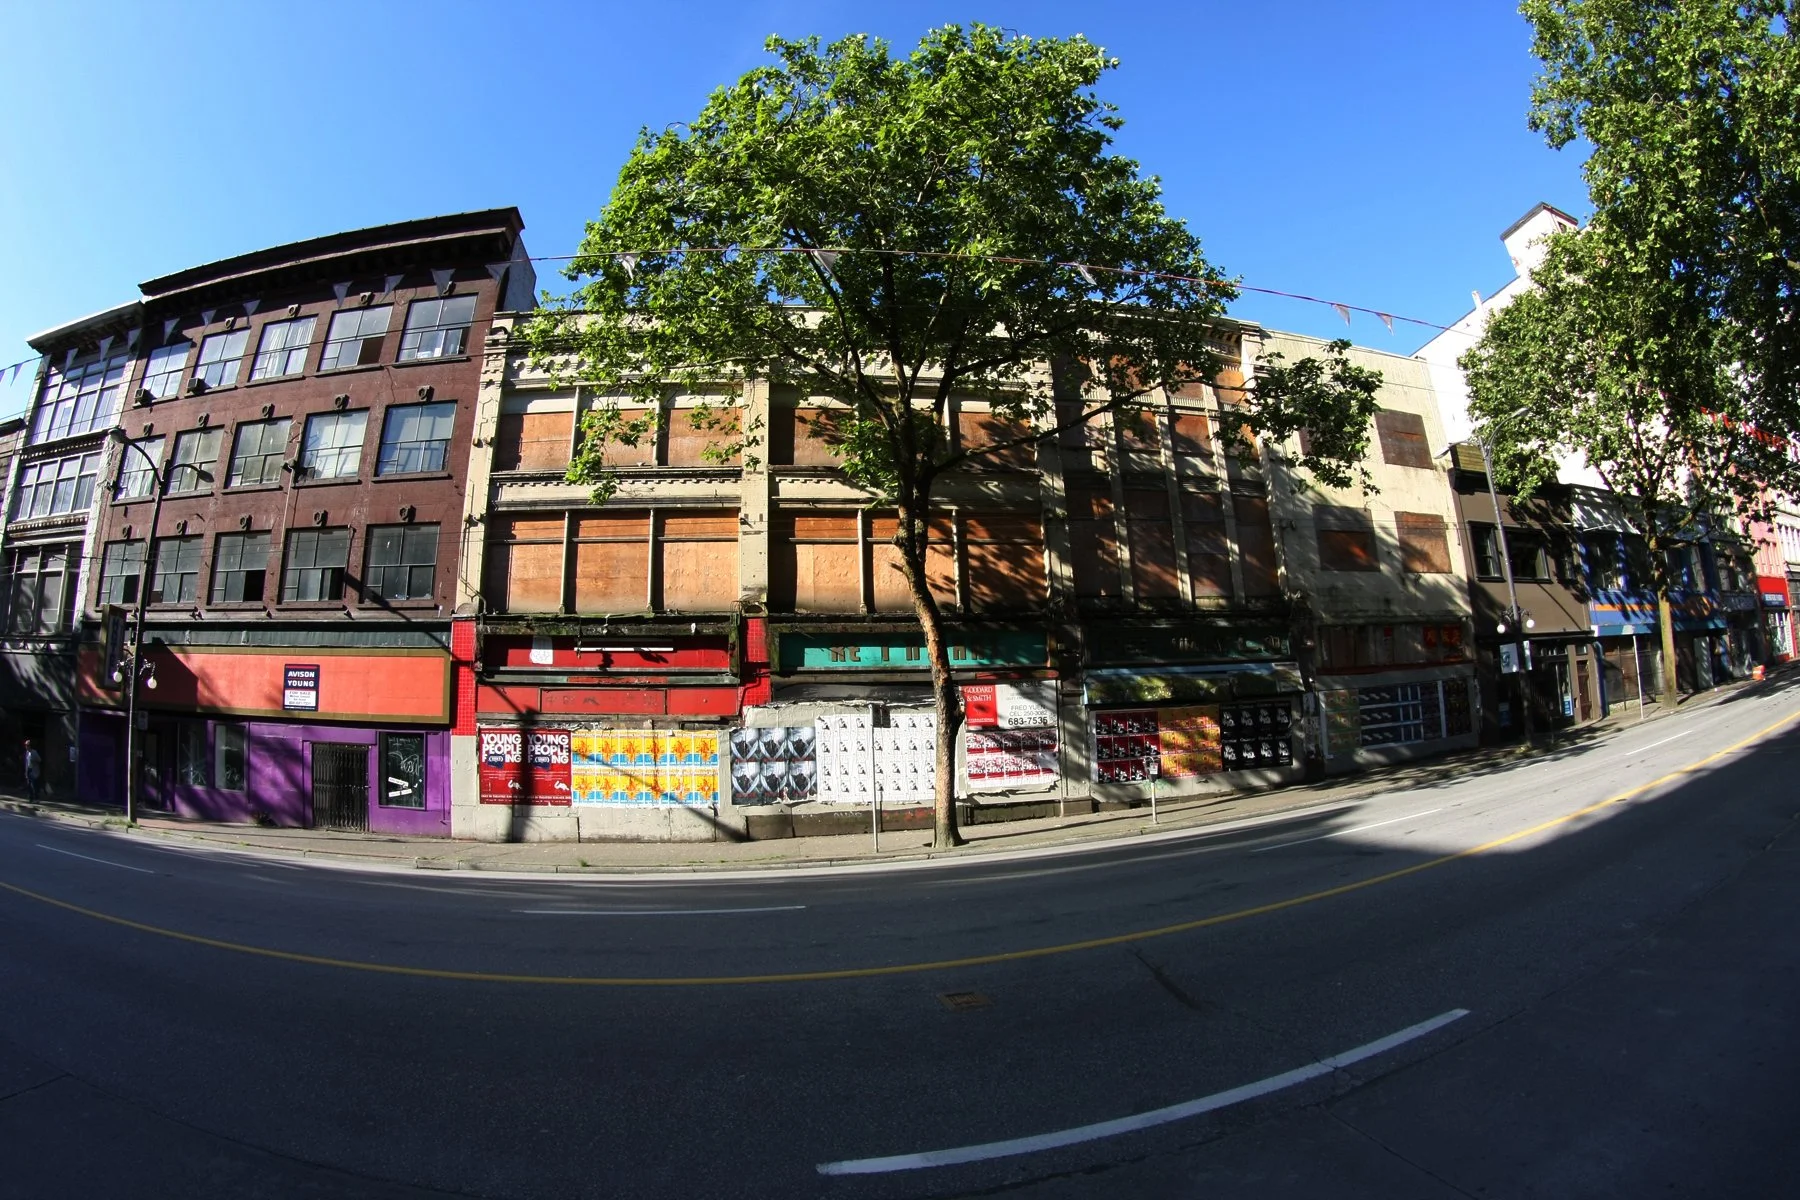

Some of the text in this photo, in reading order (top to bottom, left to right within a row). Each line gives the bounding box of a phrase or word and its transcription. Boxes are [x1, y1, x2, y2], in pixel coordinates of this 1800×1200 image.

[481, 733, 522, 744] YOUNG
[527, 734, 569, 745] YOUNG
[481, 743, 522, 755] PEOPLE
[528, 744, 569, 756] PEOPLE
